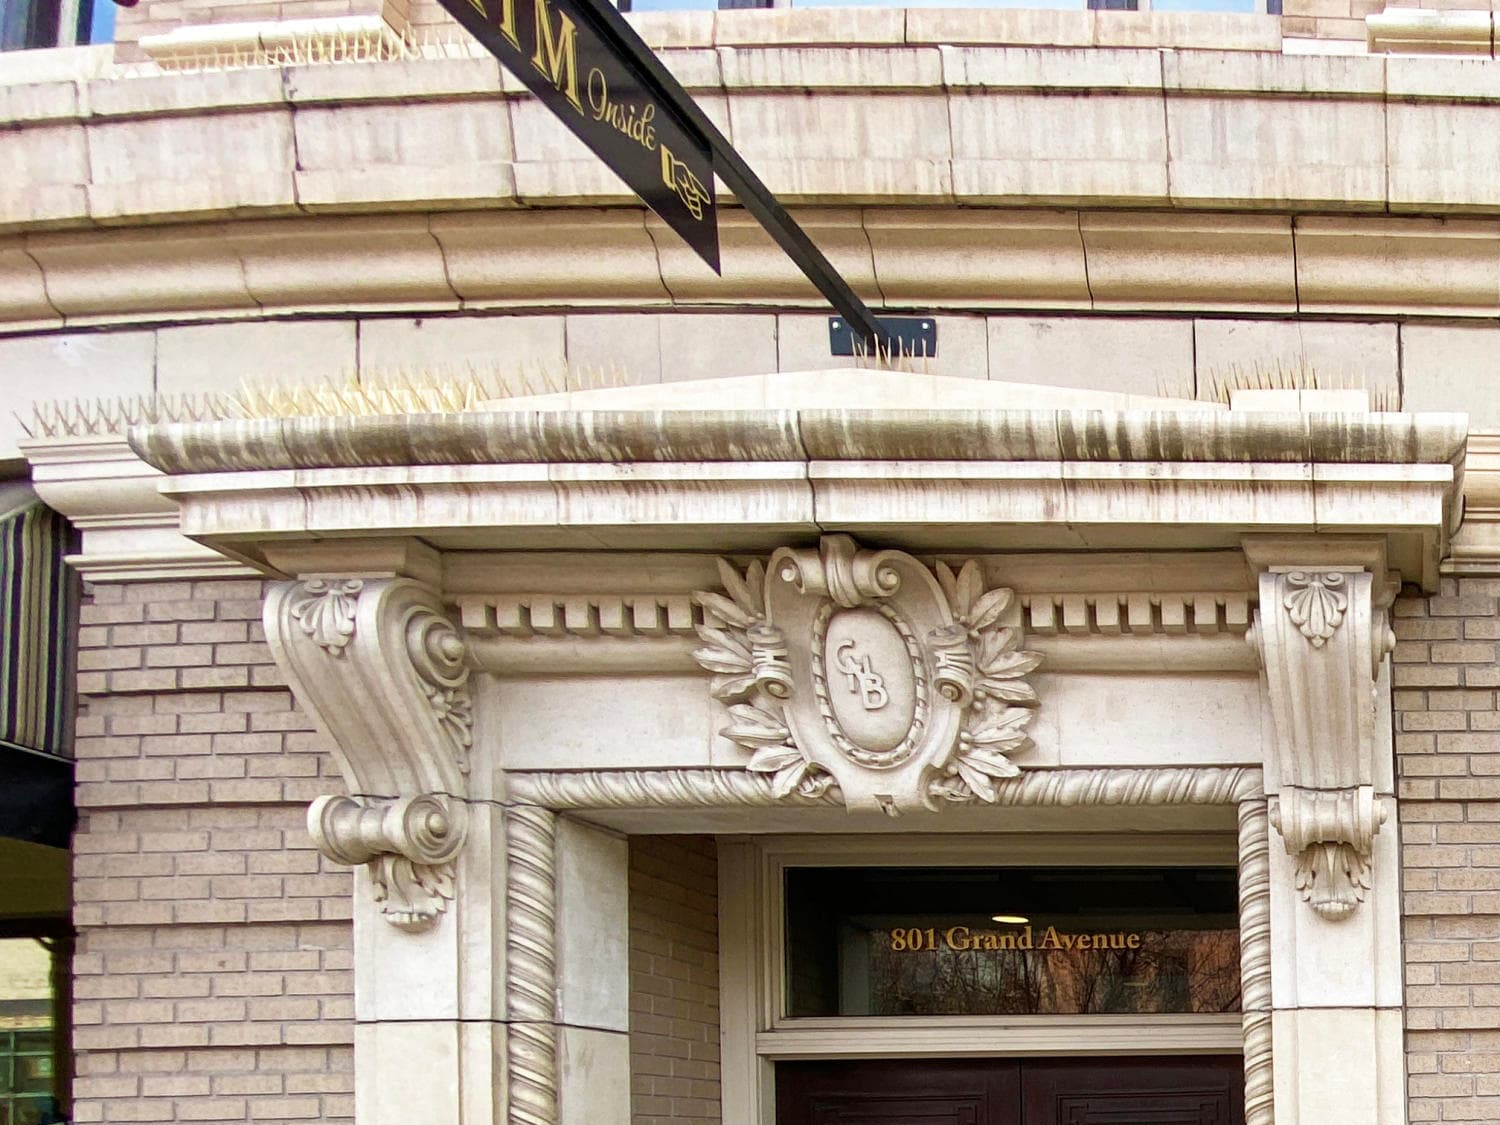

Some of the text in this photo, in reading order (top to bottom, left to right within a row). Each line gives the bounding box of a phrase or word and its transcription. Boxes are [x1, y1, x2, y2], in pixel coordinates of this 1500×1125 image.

[587, 67, 657, 151] Inside
[891, 925, 1141, 951] 801 Grand Avenue
